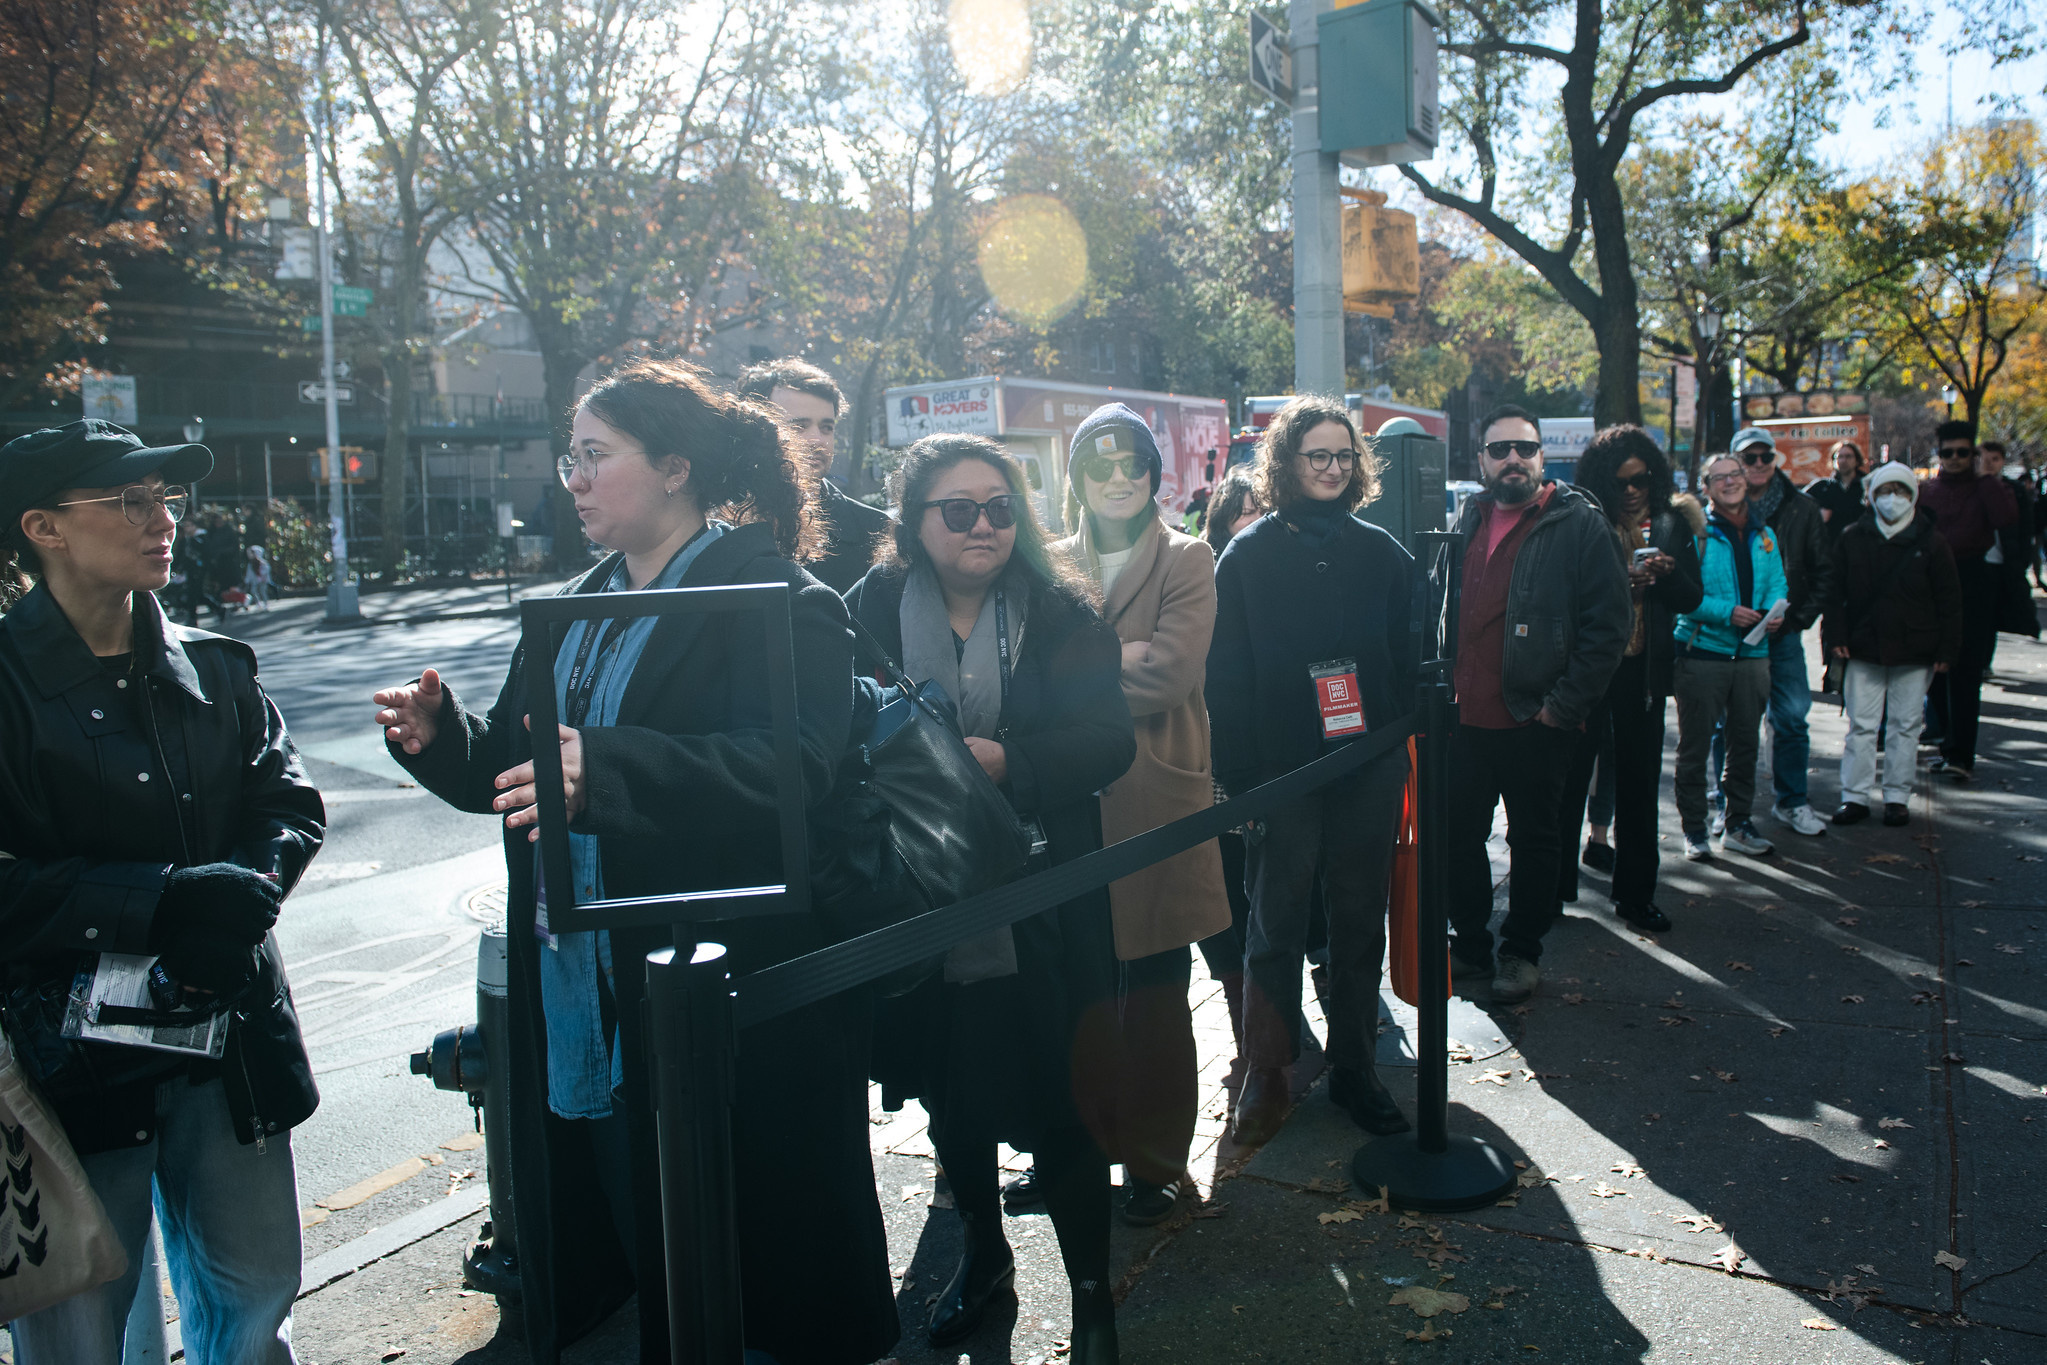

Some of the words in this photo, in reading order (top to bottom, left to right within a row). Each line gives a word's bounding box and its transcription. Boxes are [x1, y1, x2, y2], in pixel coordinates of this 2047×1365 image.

[1264, 44, 1283, 80] ONE
[932, 388, 970, 405] GREAT
[933, 399, 988, 416] MOVERS
[1185, 426, 1220, 454] MOVE
[573, 665, 581, 678] NYC
[569, 677, 578, 690] DOC
[584, 676, 593, 689] NYC
[1331, 683, 1344, 691] DOC
[1332, 690, 1346, 699] NYC
[1324, 702, 1358, 712] FILMMAKER
[156, 972, 168, 984] NYC
